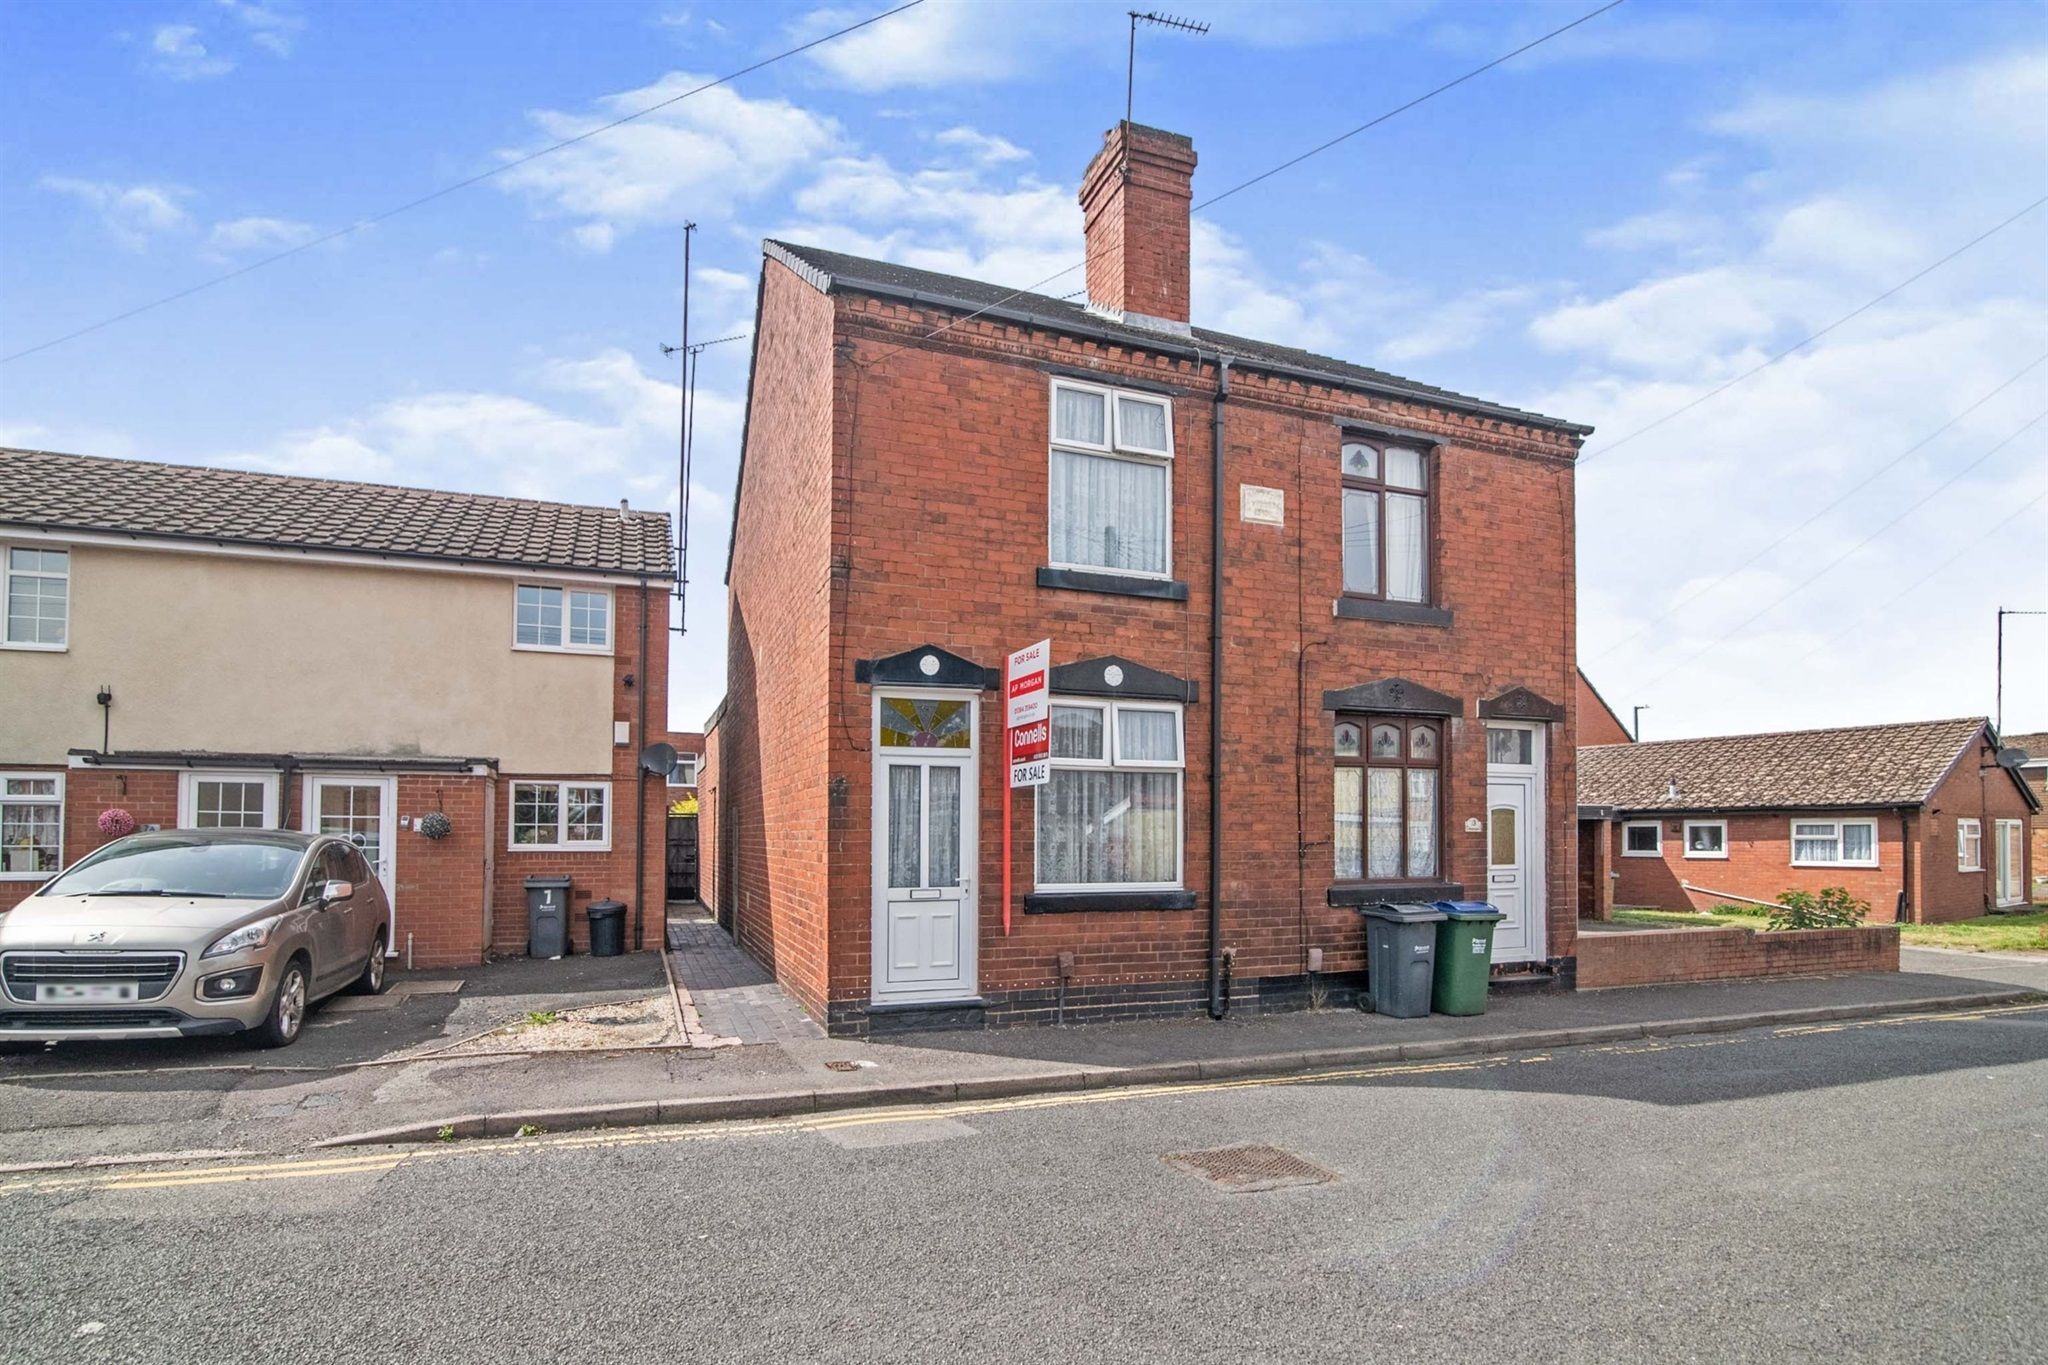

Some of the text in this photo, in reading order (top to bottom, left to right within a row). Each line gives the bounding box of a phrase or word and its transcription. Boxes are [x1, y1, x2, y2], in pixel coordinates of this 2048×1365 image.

[1014, 648, 1040, 666] FOR SALE
[1019, 676, 1042, 689] MORGAN
[1014, 723, 1047, 748] Connells
[1013, 764, 1045, 783] FOR SALE
